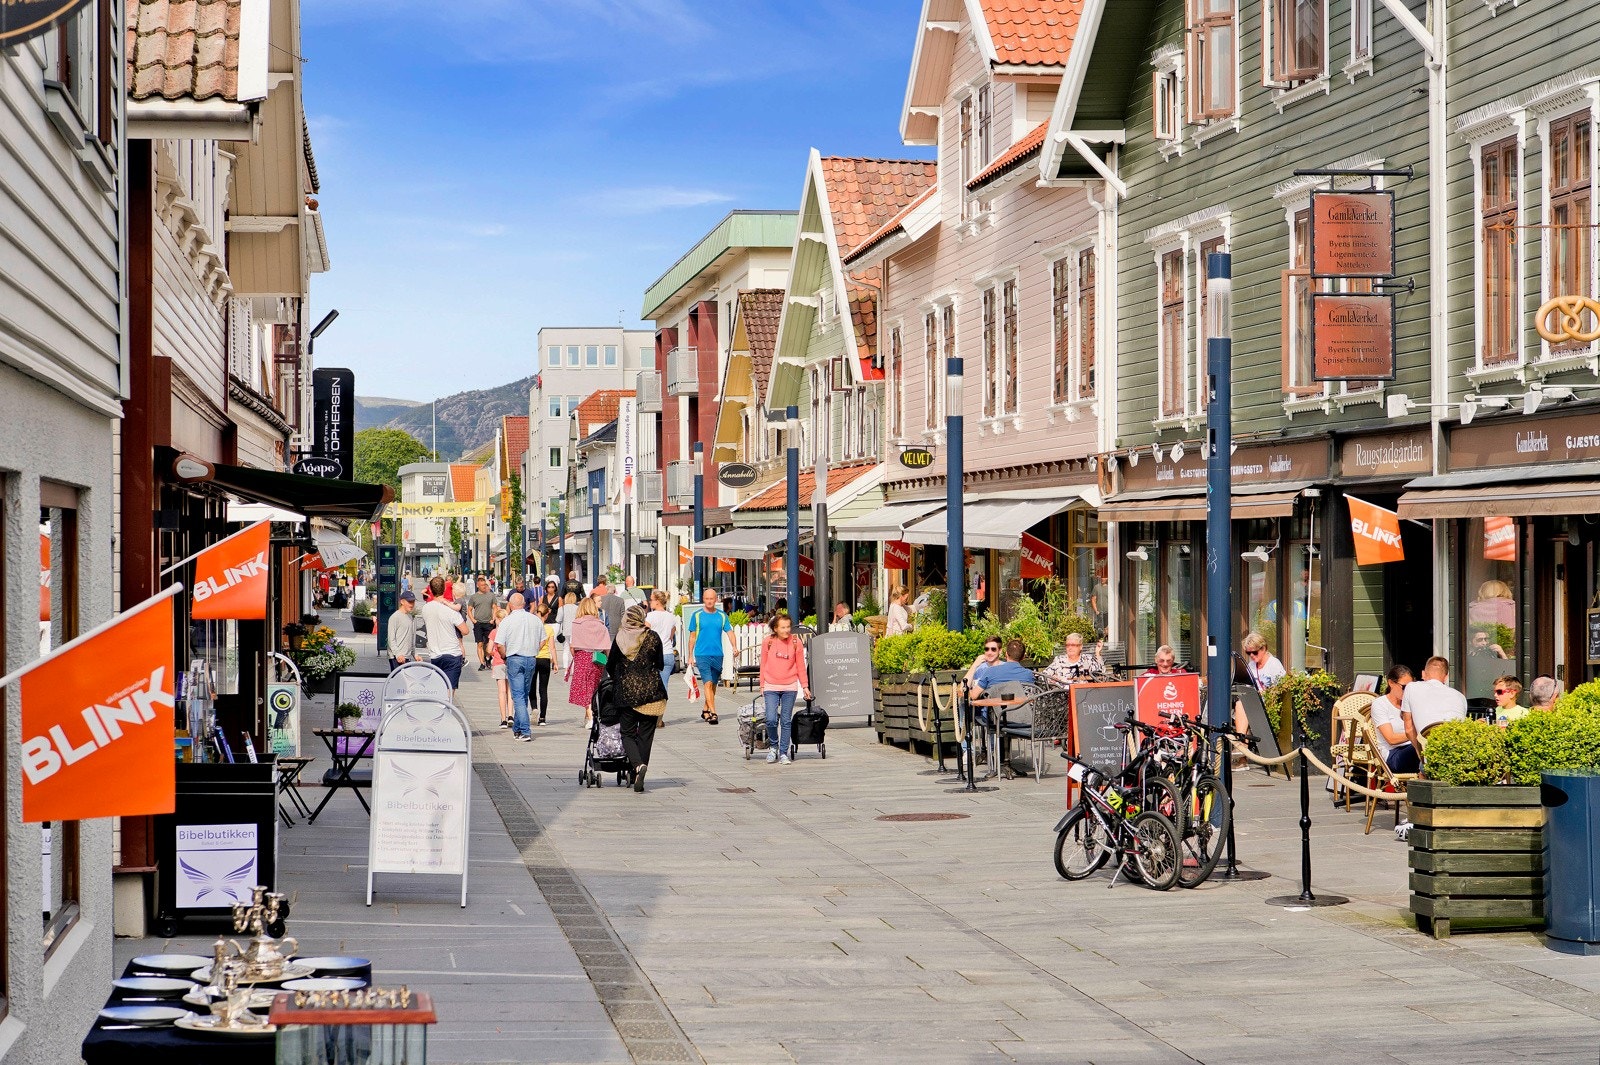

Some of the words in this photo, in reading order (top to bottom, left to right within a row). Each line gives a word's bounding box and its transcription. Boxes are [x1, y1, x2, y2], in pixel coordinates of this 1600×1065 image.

[903, 452, 931, 466] VELVET
[1356, 440, 1423, 470] Raugstadgården
[298, 463, 336, 477] Agape
[719, 469, 755, 480] Annabelle
[1352, 518, 1402, 548] BLINK
[884, 544, 911, 563] BLINK
[1021, 546, 1054, 571] BLINK
[193, 551, 269, 602] BLINK
[799, 564, 816, 577] BLIN
[22, 666, 174, 786] BLINK
[396, 735, 452, 743] Bibelbutikken
[387, 801, 454, 811] Bibelbutikken
[179, 830, 255, 840] Bibelbutikken
